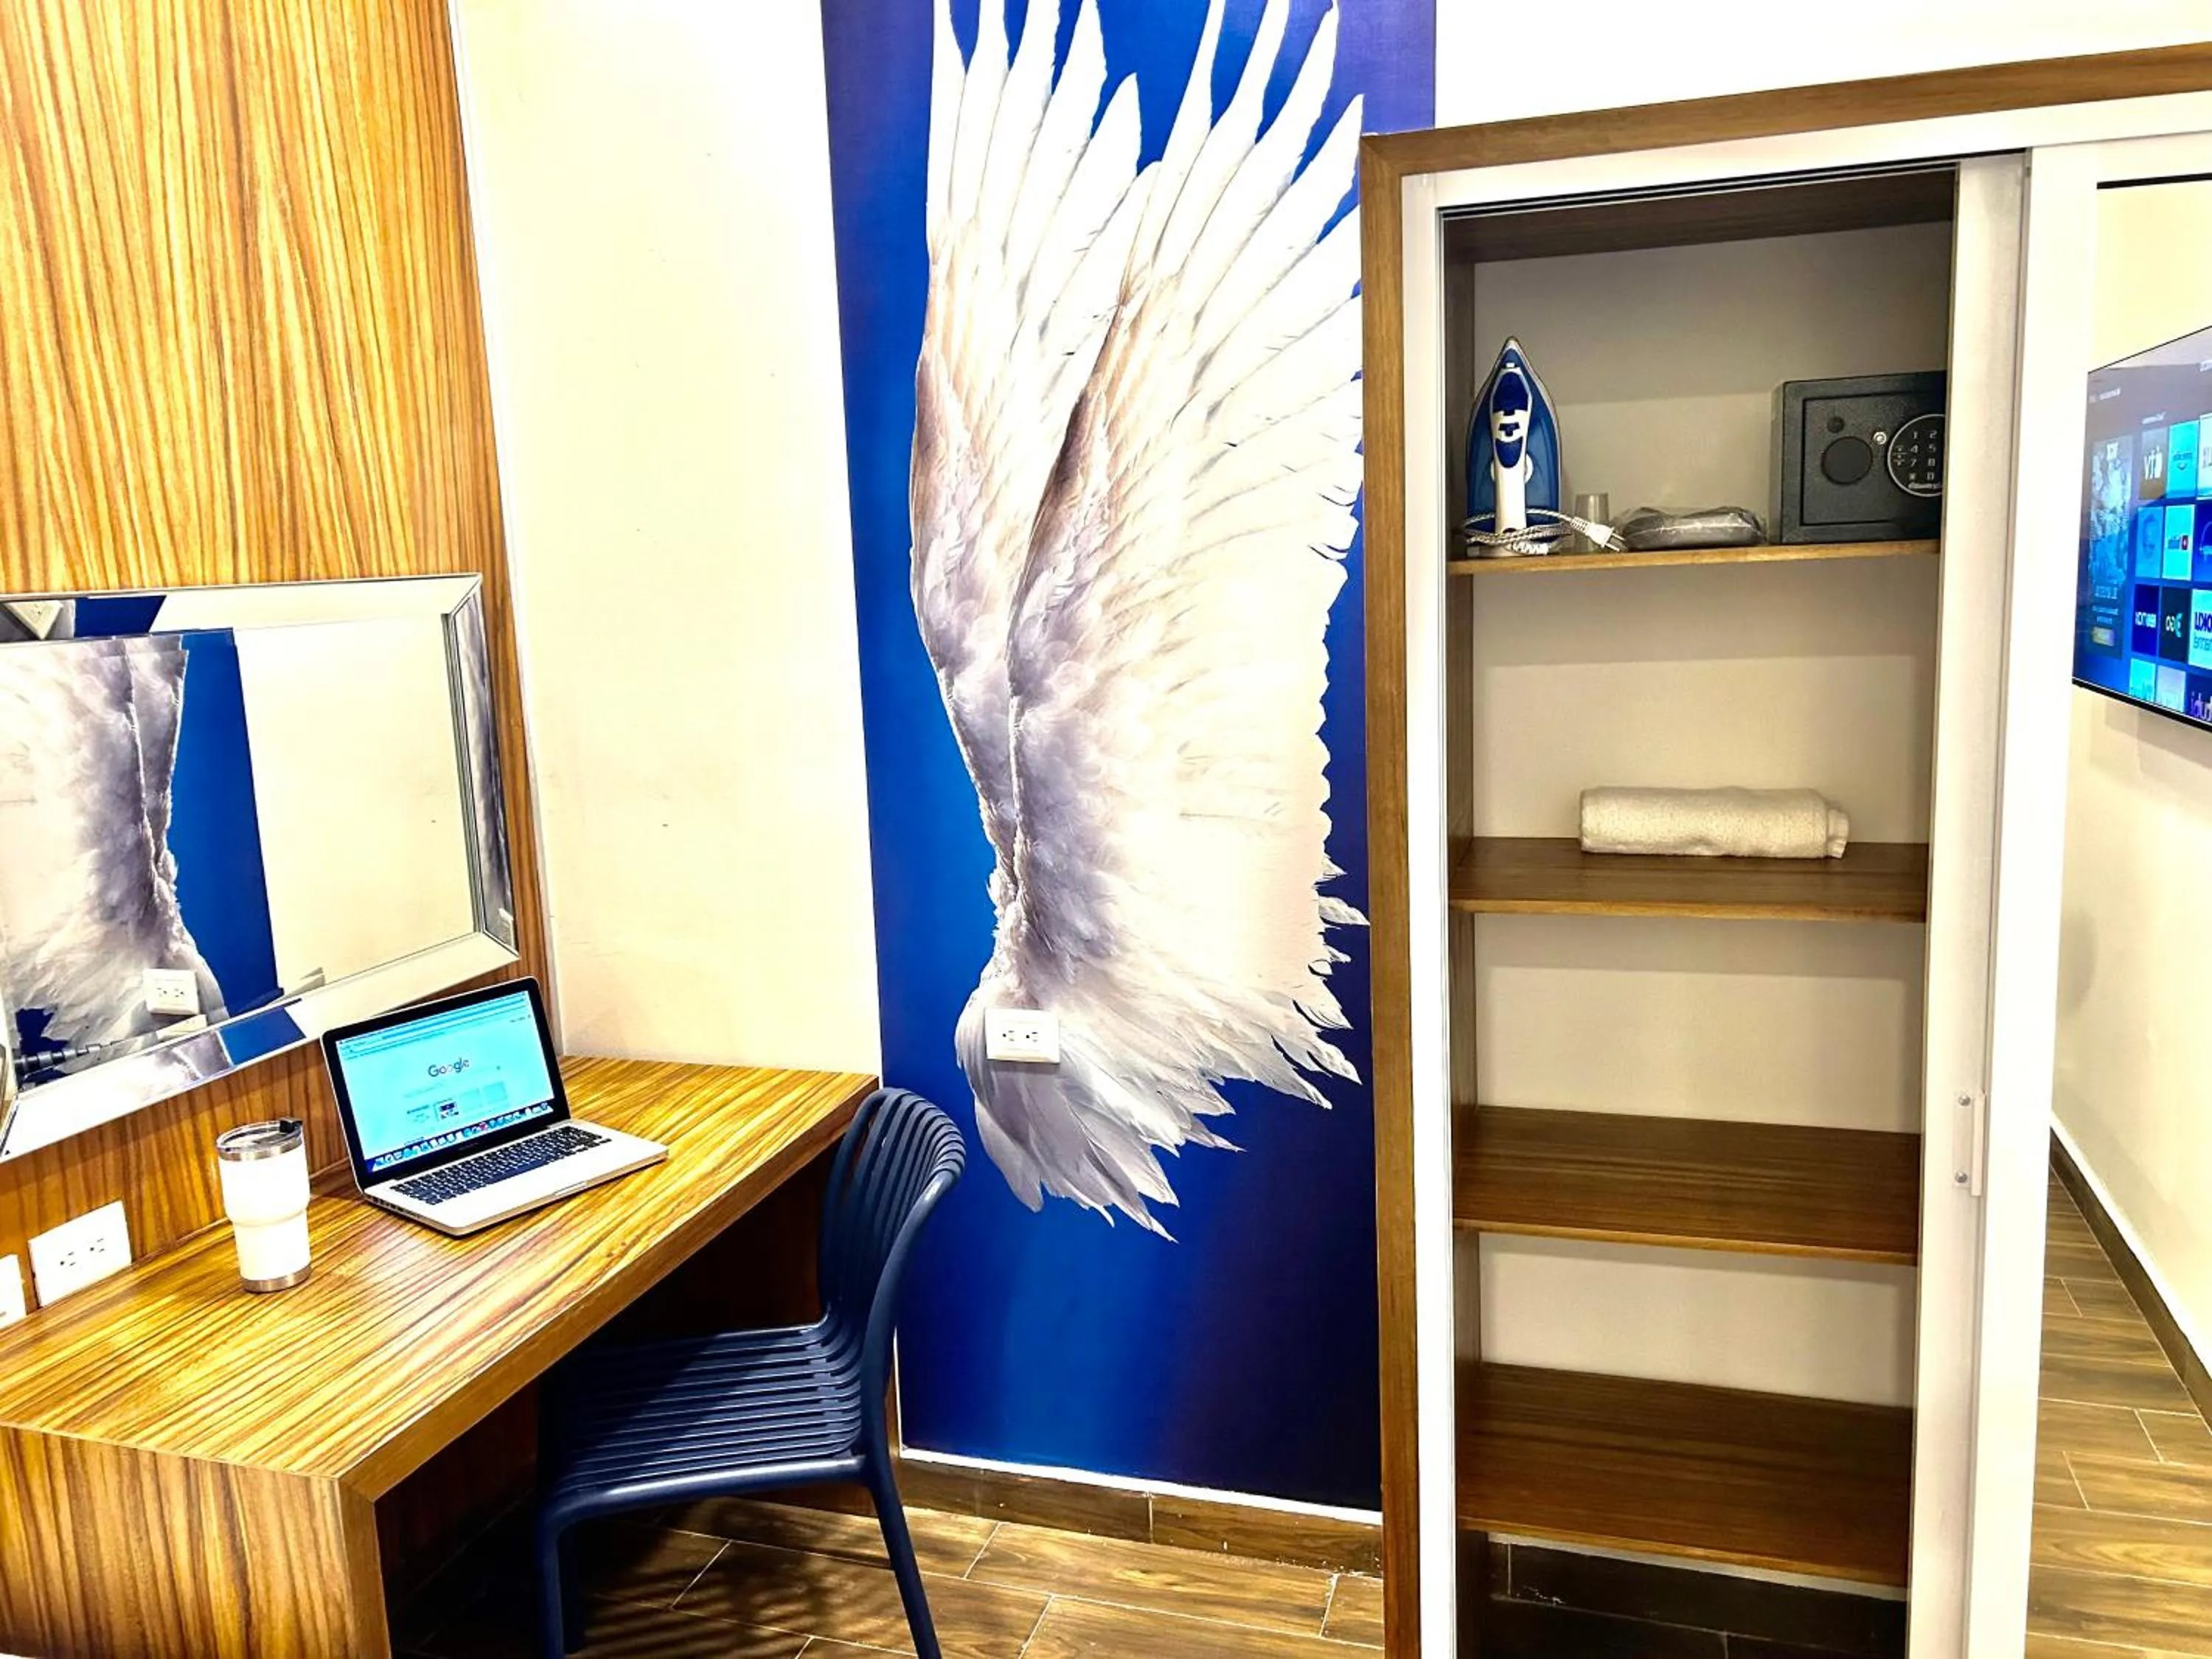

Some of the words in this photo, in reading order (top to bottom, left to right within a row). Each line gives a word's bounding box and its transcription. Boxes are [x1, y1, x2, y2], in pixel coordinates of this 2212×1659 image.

[1913, 431, 1918, 439] 1
[1930, 430, 1938, 439] 2
[1911, 444, 1919, 453] 4
[1929, 443, 1937, 453] 5
[1911, 458, 1917, 467] 7
[428, 1057, 470, 1077] Google
